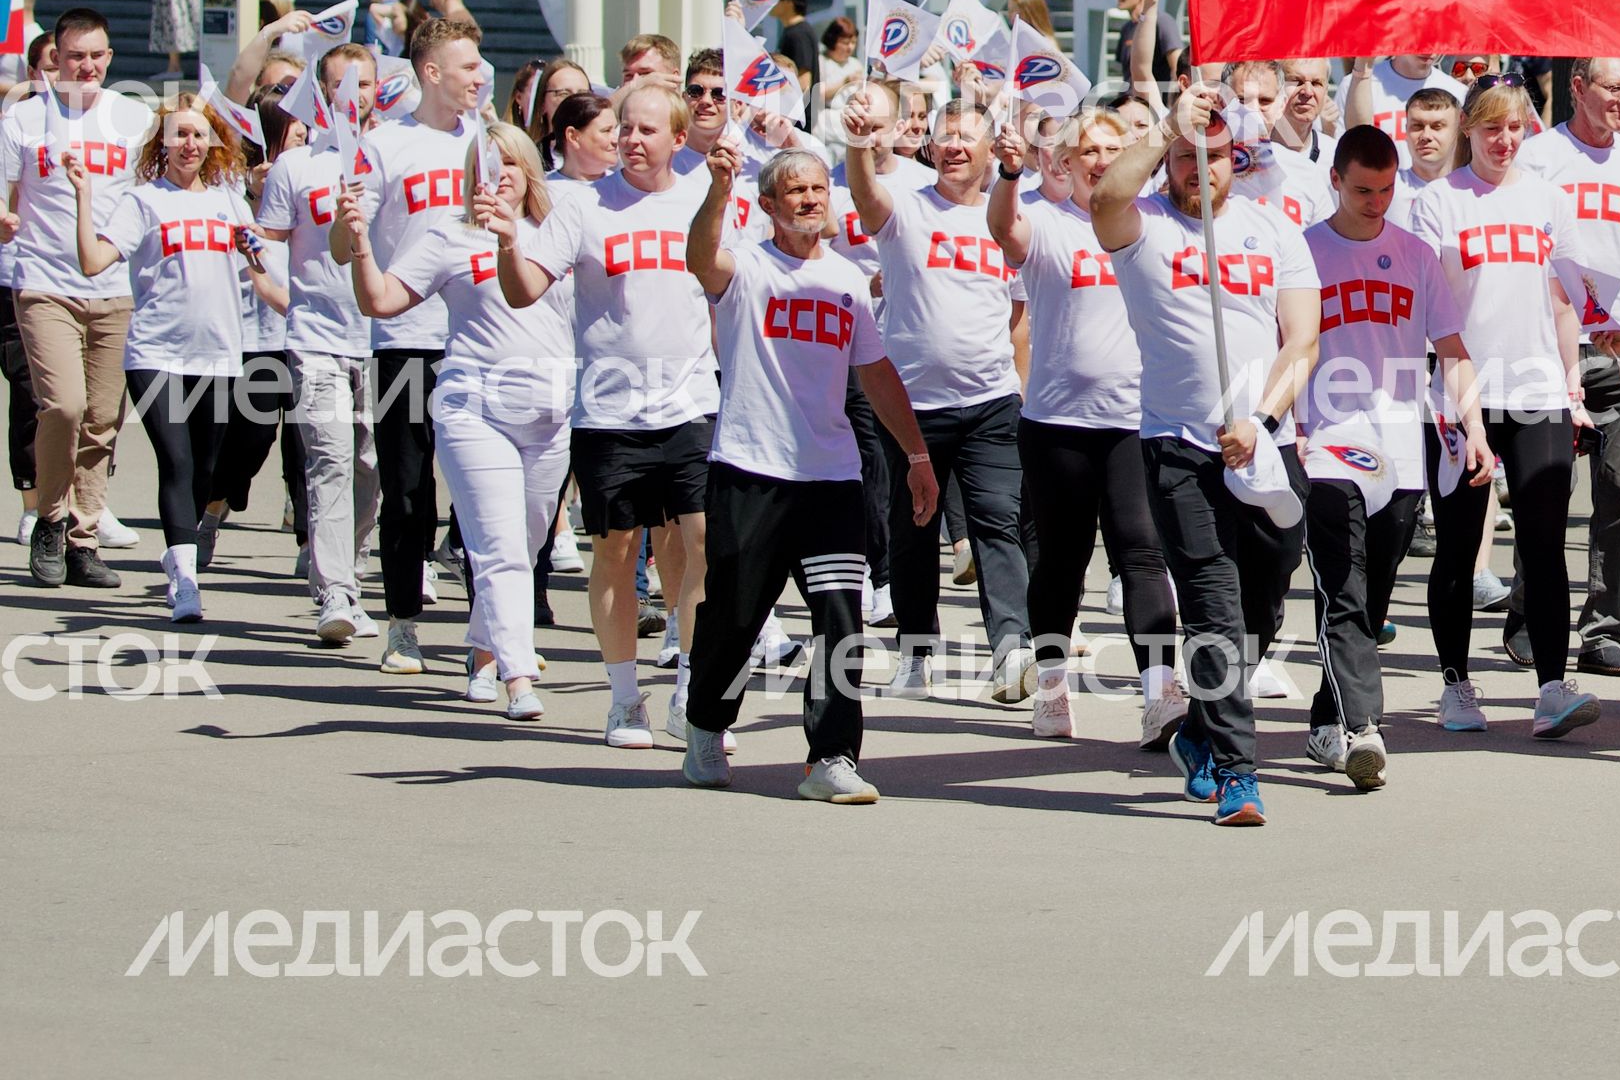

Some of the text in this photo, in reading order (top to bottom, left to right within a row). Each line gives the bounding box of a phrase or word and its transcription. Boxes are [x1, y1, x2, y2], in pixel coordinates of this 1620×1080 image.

[604, 230, 687, 277] ССС
[1459, 224, 1555, 271] СССР
[763, 296, 854, 351] СССР
